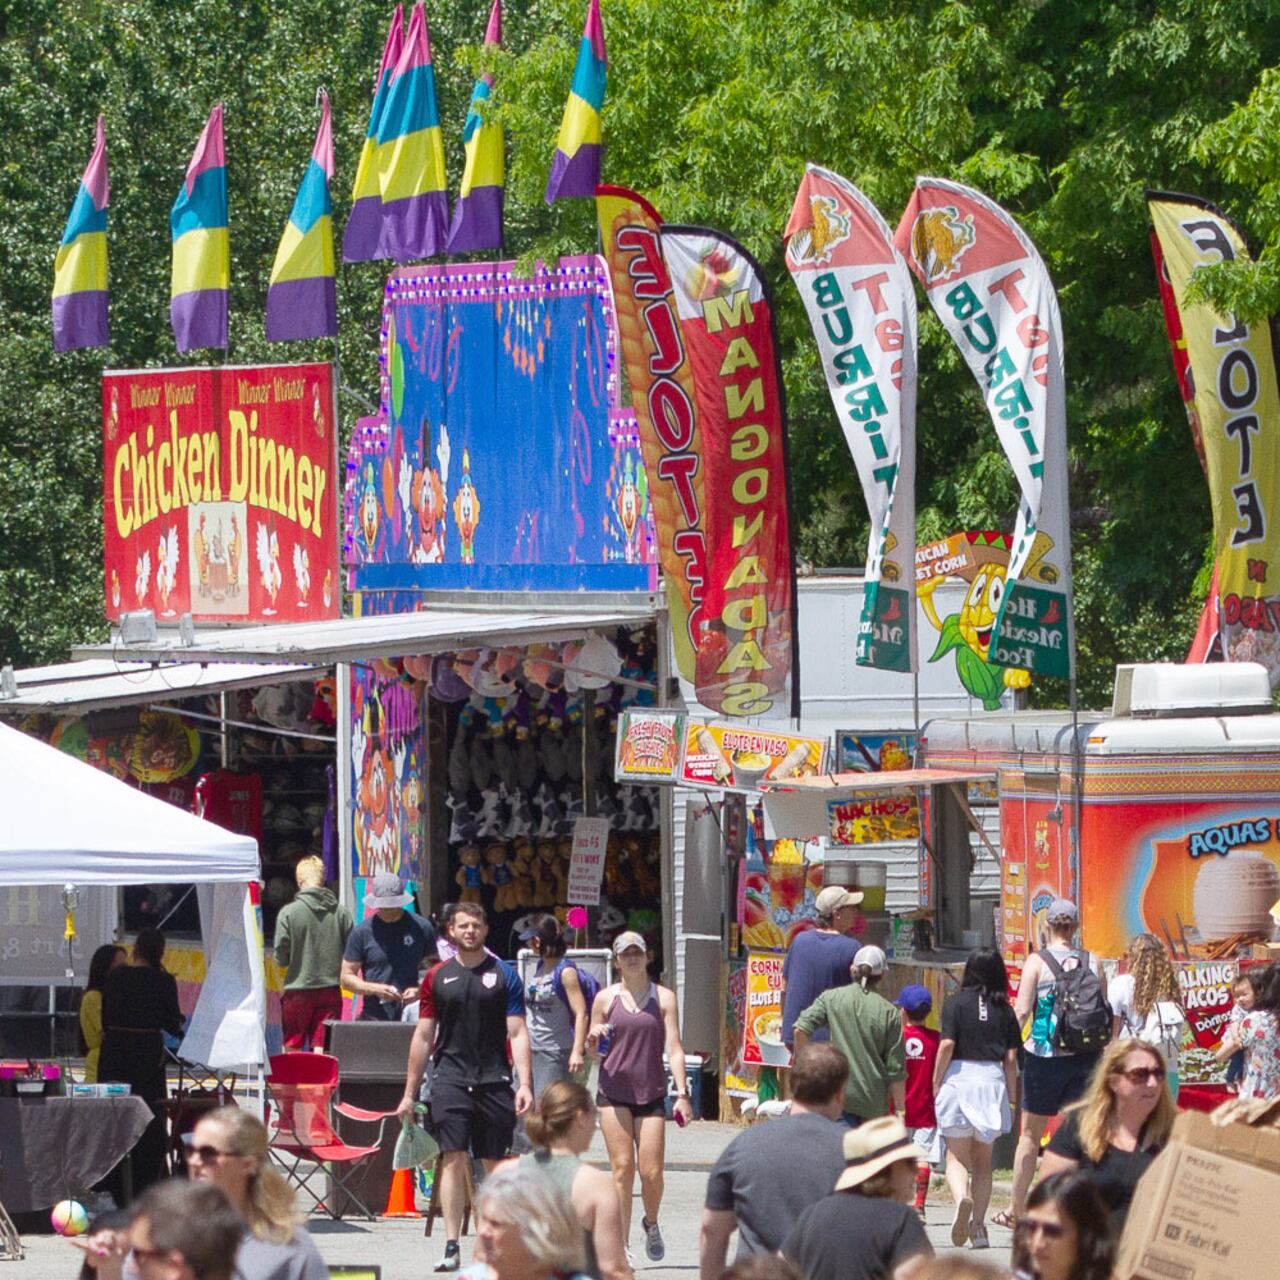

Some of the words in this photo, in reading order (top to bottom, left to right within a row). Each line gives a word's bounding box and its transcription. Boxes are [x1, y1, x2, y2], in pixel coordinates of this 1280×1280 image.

[131, 384, 160, 409] Winner
[165, 382, 196, 408] Winner
[238, 379, 270, 405] Winner
[274, 377, 306, 403] Winner
[114, 409, 222, 539] Chicken
[229, 410, 326, 539] Dinner
[934, 553, 968, 575] CORN
[722, 732, 749, 750] ELOTE
[749, 736, 762, 750] EN
[762, 739, 788, 757] VASO
[835, 799, 911, 823] NACHOS
[1189, 818, 1271, 857] AQUAS
[750, 960, 780, 974] CORN
[1179, 964, 1234, 988] ALKING
[767, 974, 782, 988] CU
[750, 992, 772, 1006] ELOTE
